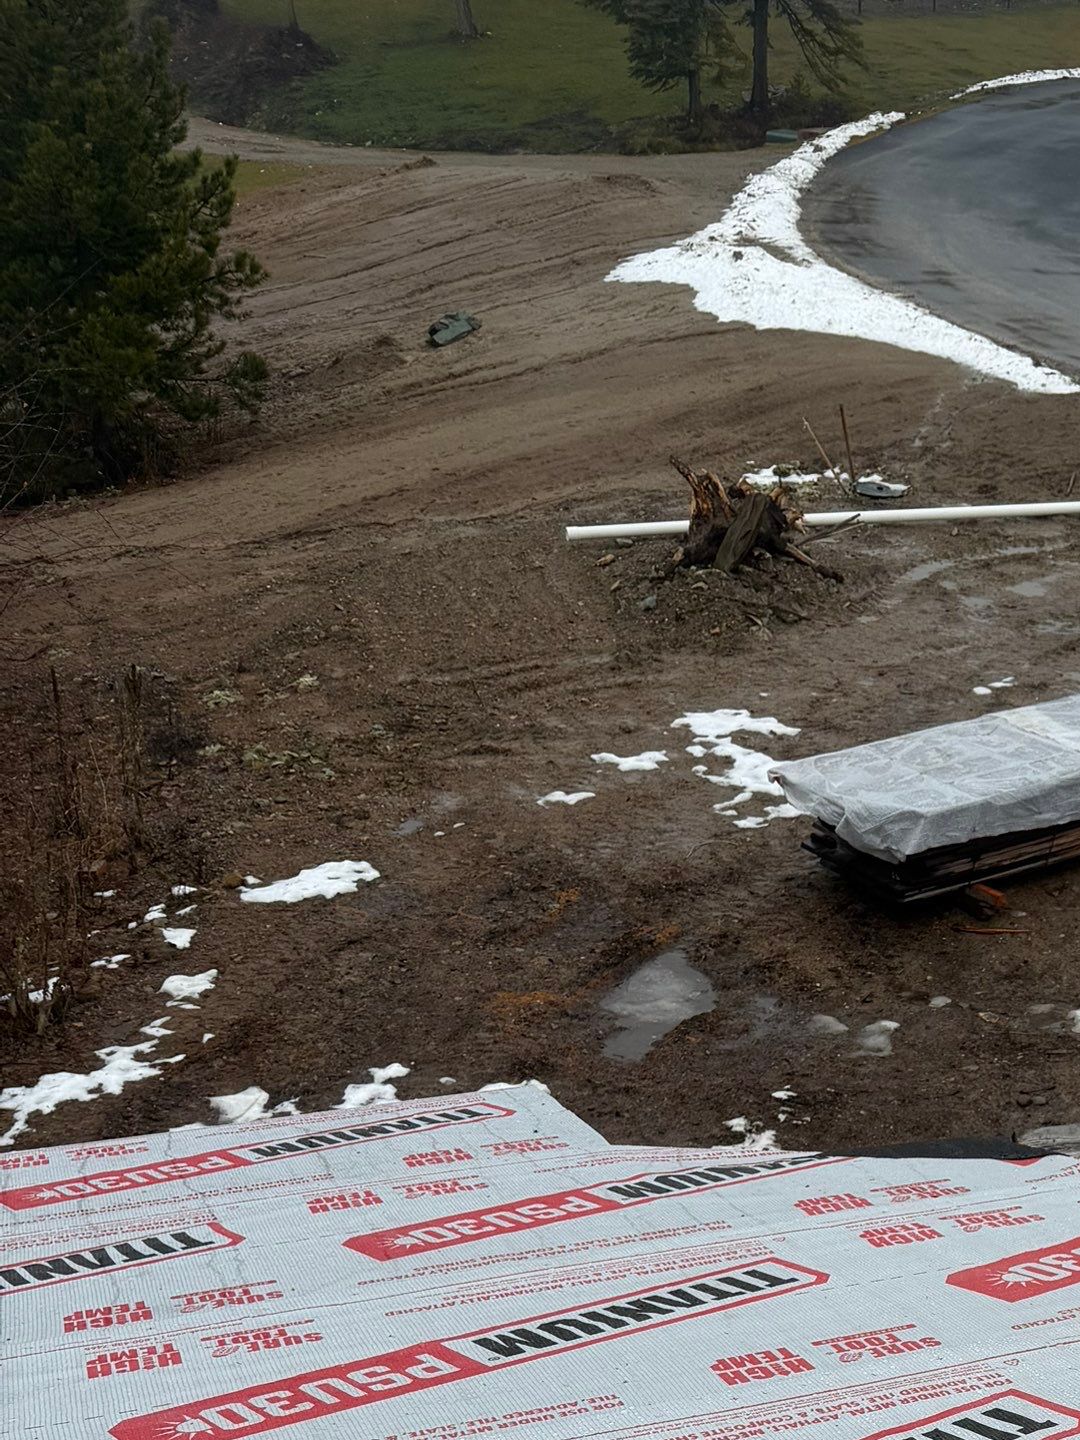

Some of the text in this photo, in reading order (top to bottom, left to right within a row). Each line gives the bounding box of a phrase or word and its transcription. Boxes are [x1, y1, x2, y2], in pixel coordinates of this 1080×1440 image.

[52, 1156, 234, 1197] PSU30
[409, 1194, 599, 1244] PSU30
[0, 1230, 215, 1289] TITANI
[63, 1310, 154, 1333] HIGH
[470, 1269, 800, 1358] TITANIUM
[86, 1343, 179, 1366] TEMP
[831, 1332, 902, 1353] FOOT
[868, 1337, 942, 1358] SURE
[86, 1351, 183, 1380] HIGH
[709, 1346, 801, 1377] TEMP
[715, 1358, 816, 1387] HIGH
[199, 1352, 462, 1431] PSU30
